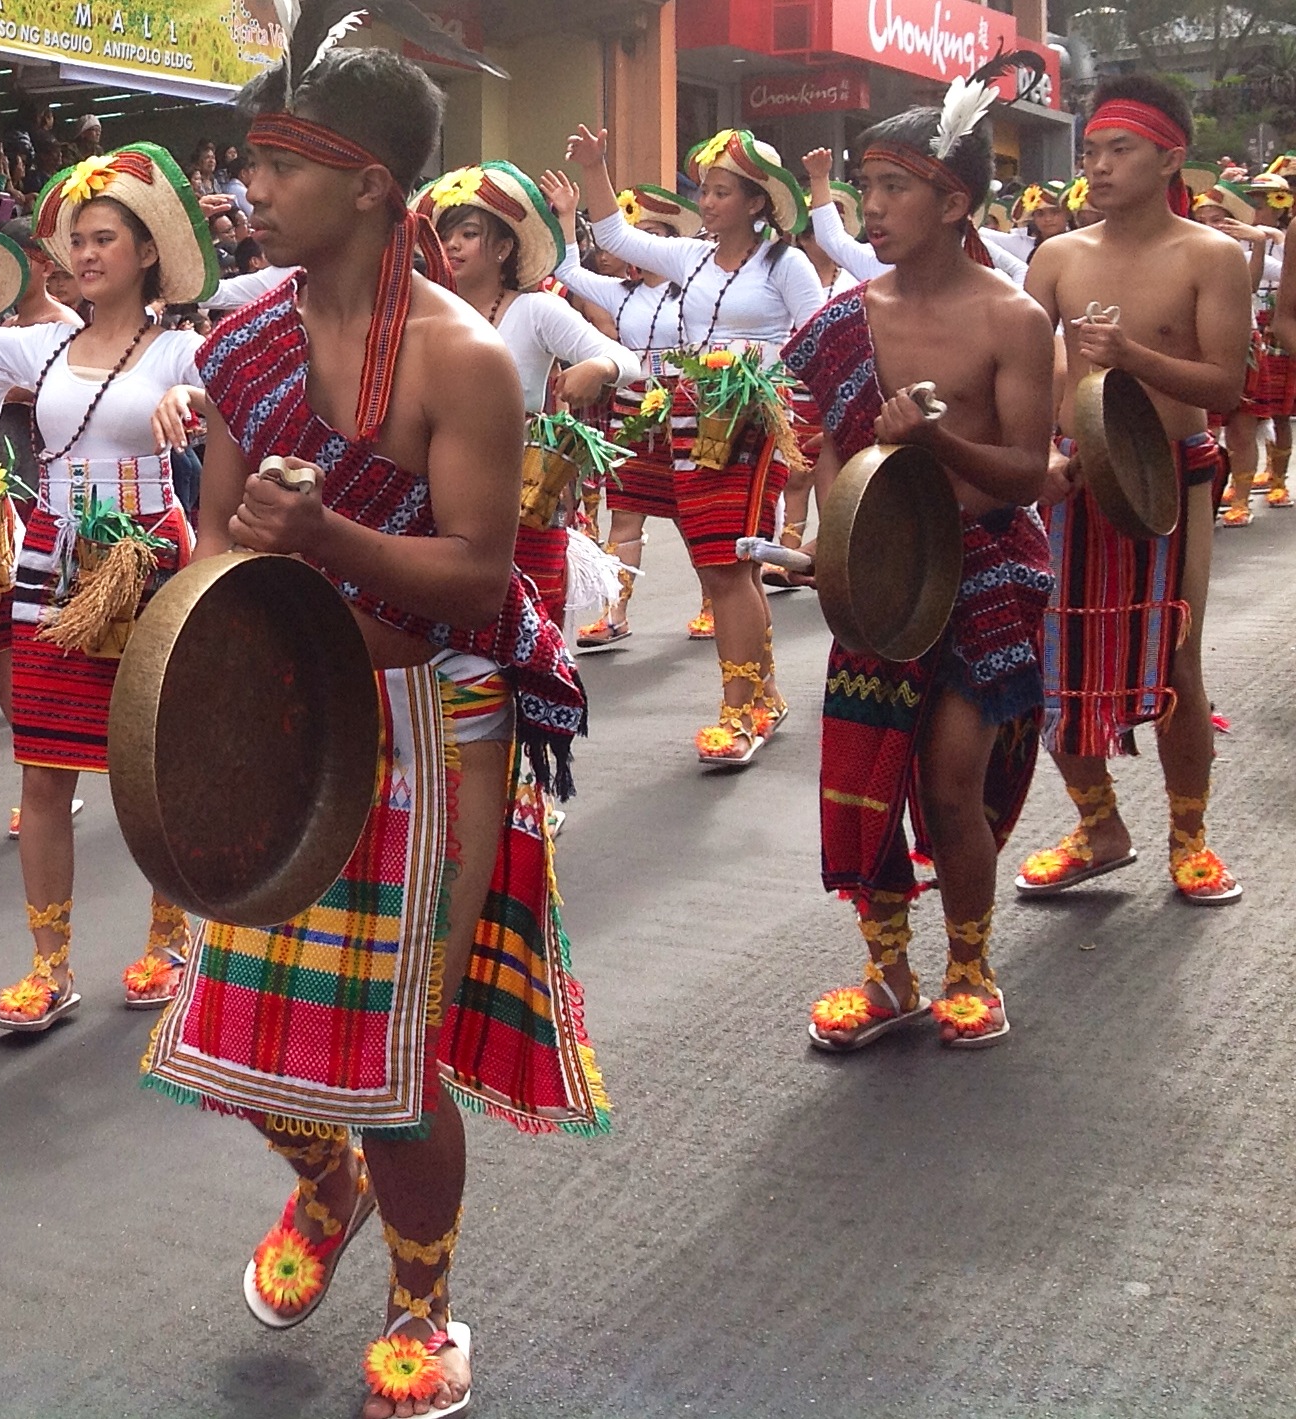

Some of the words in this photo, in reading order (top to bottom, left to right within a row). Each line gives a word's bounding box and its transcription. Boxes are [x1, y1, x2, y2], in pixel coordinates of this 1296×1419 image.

[75, 3, 178, 44] MALL
[868, 0, 976, 80] Chowking
[20, 24, 40, 44] NG
[44, 28, 93, 54] BAGUIO
[103, 40, 162, 66] ANTIPOLO
[164, 50, 196, 72] BLDG.
[750, 83, 838, 108] Chowking
